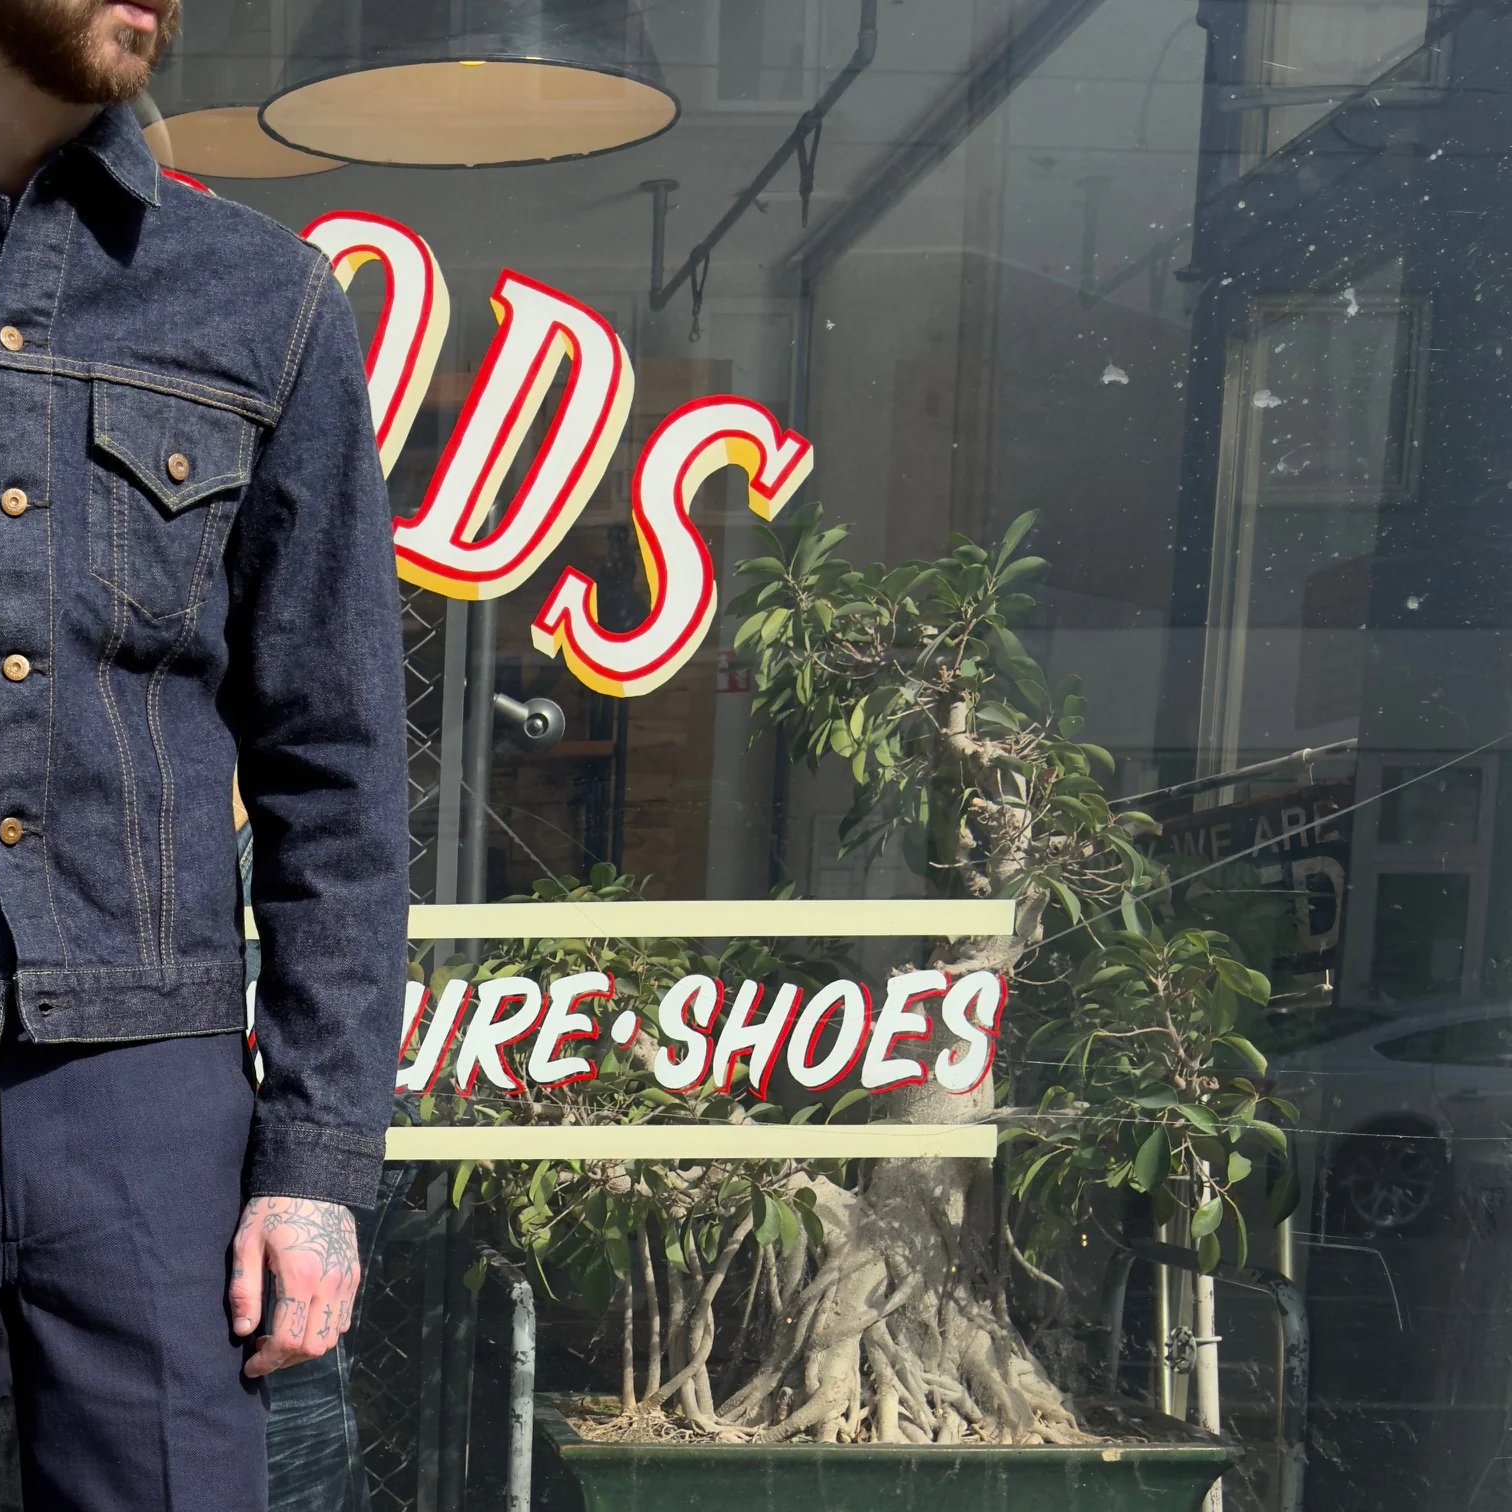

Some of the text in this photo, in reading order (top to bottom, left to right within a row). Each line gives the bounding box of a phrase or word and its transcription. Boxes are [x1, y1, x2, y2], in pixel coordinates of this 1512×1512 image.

[162, 168, 814, 698] ODS
[1251, 799, 1343, 857] ARE
[394, 971, 615, 1099] URE
[653, 968, 1010, 1102] SHOES
